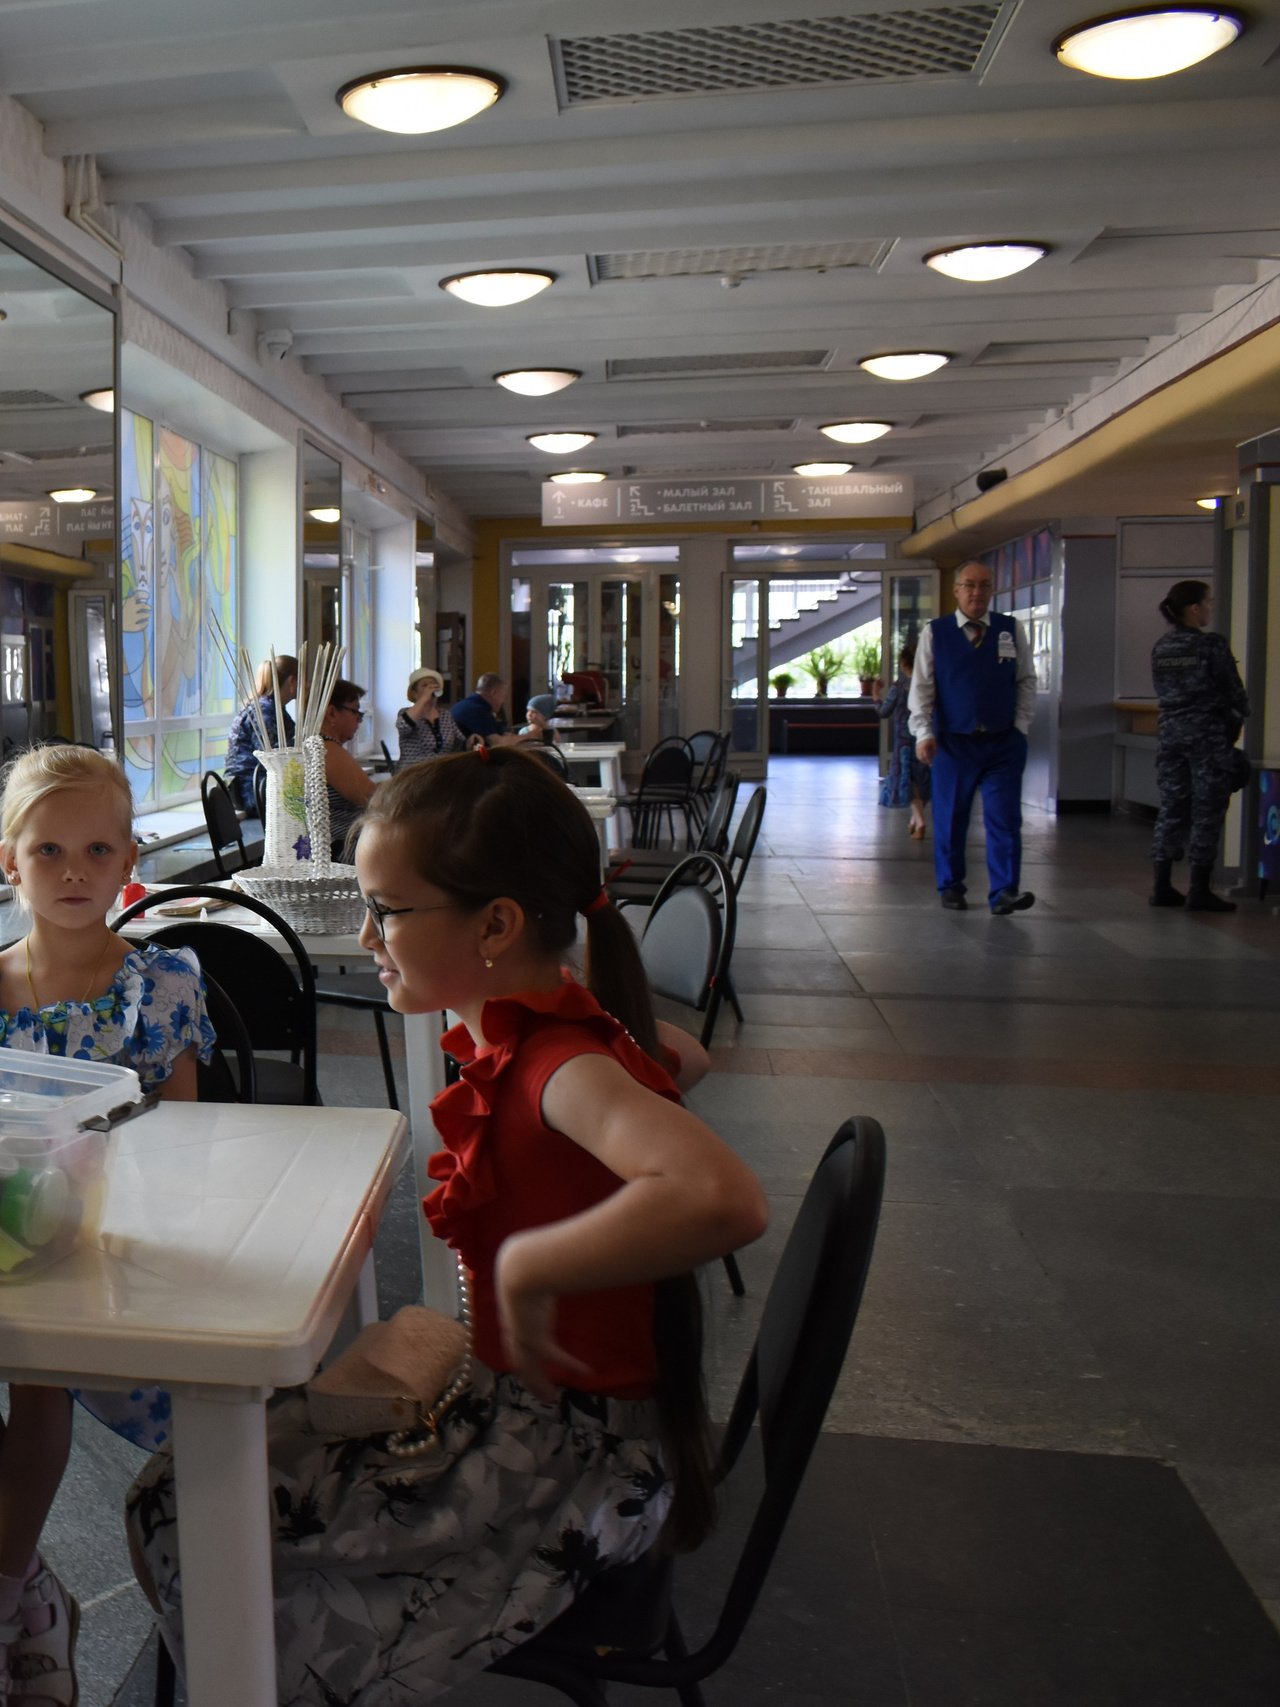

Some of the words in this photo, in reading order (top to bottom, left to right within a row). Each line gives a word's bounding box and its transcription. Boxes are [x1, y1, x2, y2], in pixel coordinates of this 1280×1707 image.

[663, 486, 709, 498] МАЛЫЙ
[712, 486, 735, 497] ЗАЛ
[808, 482, 903, 495] ТАНЦЕВАЛЬНЫЙ
[577, 497, 609, 509] КАФЕ
[663, 501, 725, 513] БАЛЕТНЫЙ
[729, 501, 752, 511] ЗАЛ
[808, 498, 831, 508] ЗАЛ
